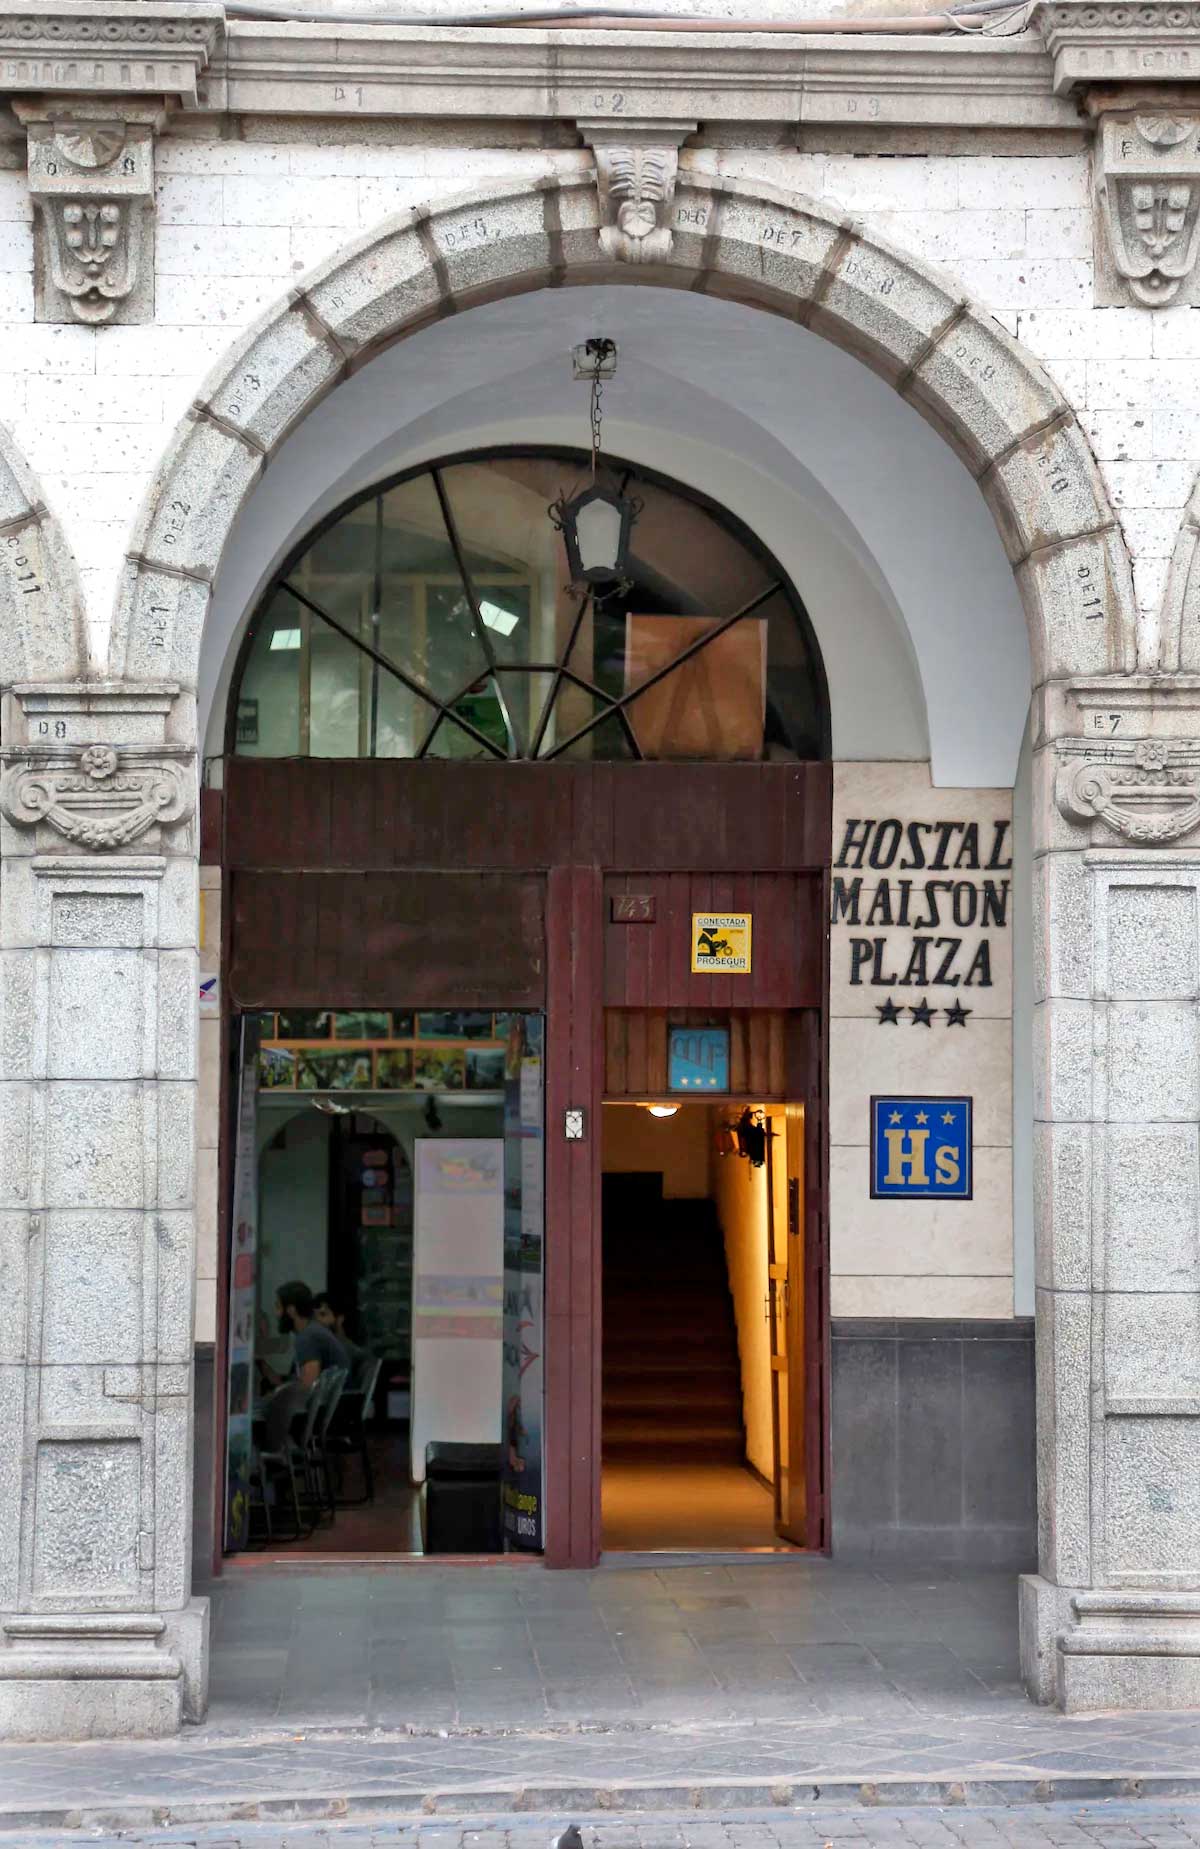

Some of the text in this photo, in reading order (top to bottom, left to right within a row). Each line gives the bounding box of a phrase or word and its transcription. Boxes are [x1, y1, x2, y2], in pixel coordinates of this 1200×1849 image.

[833, 818, 1012, 870] HOSTAL
[697, 917, 746, 926] CONECTADA
[830, 876, 1010, 929] MAISON
[696, 957, 746, 966] PROSEGUR
[849, 936, 993, 987] PLAZA
[883, 1128, 960, 1185] Hs
